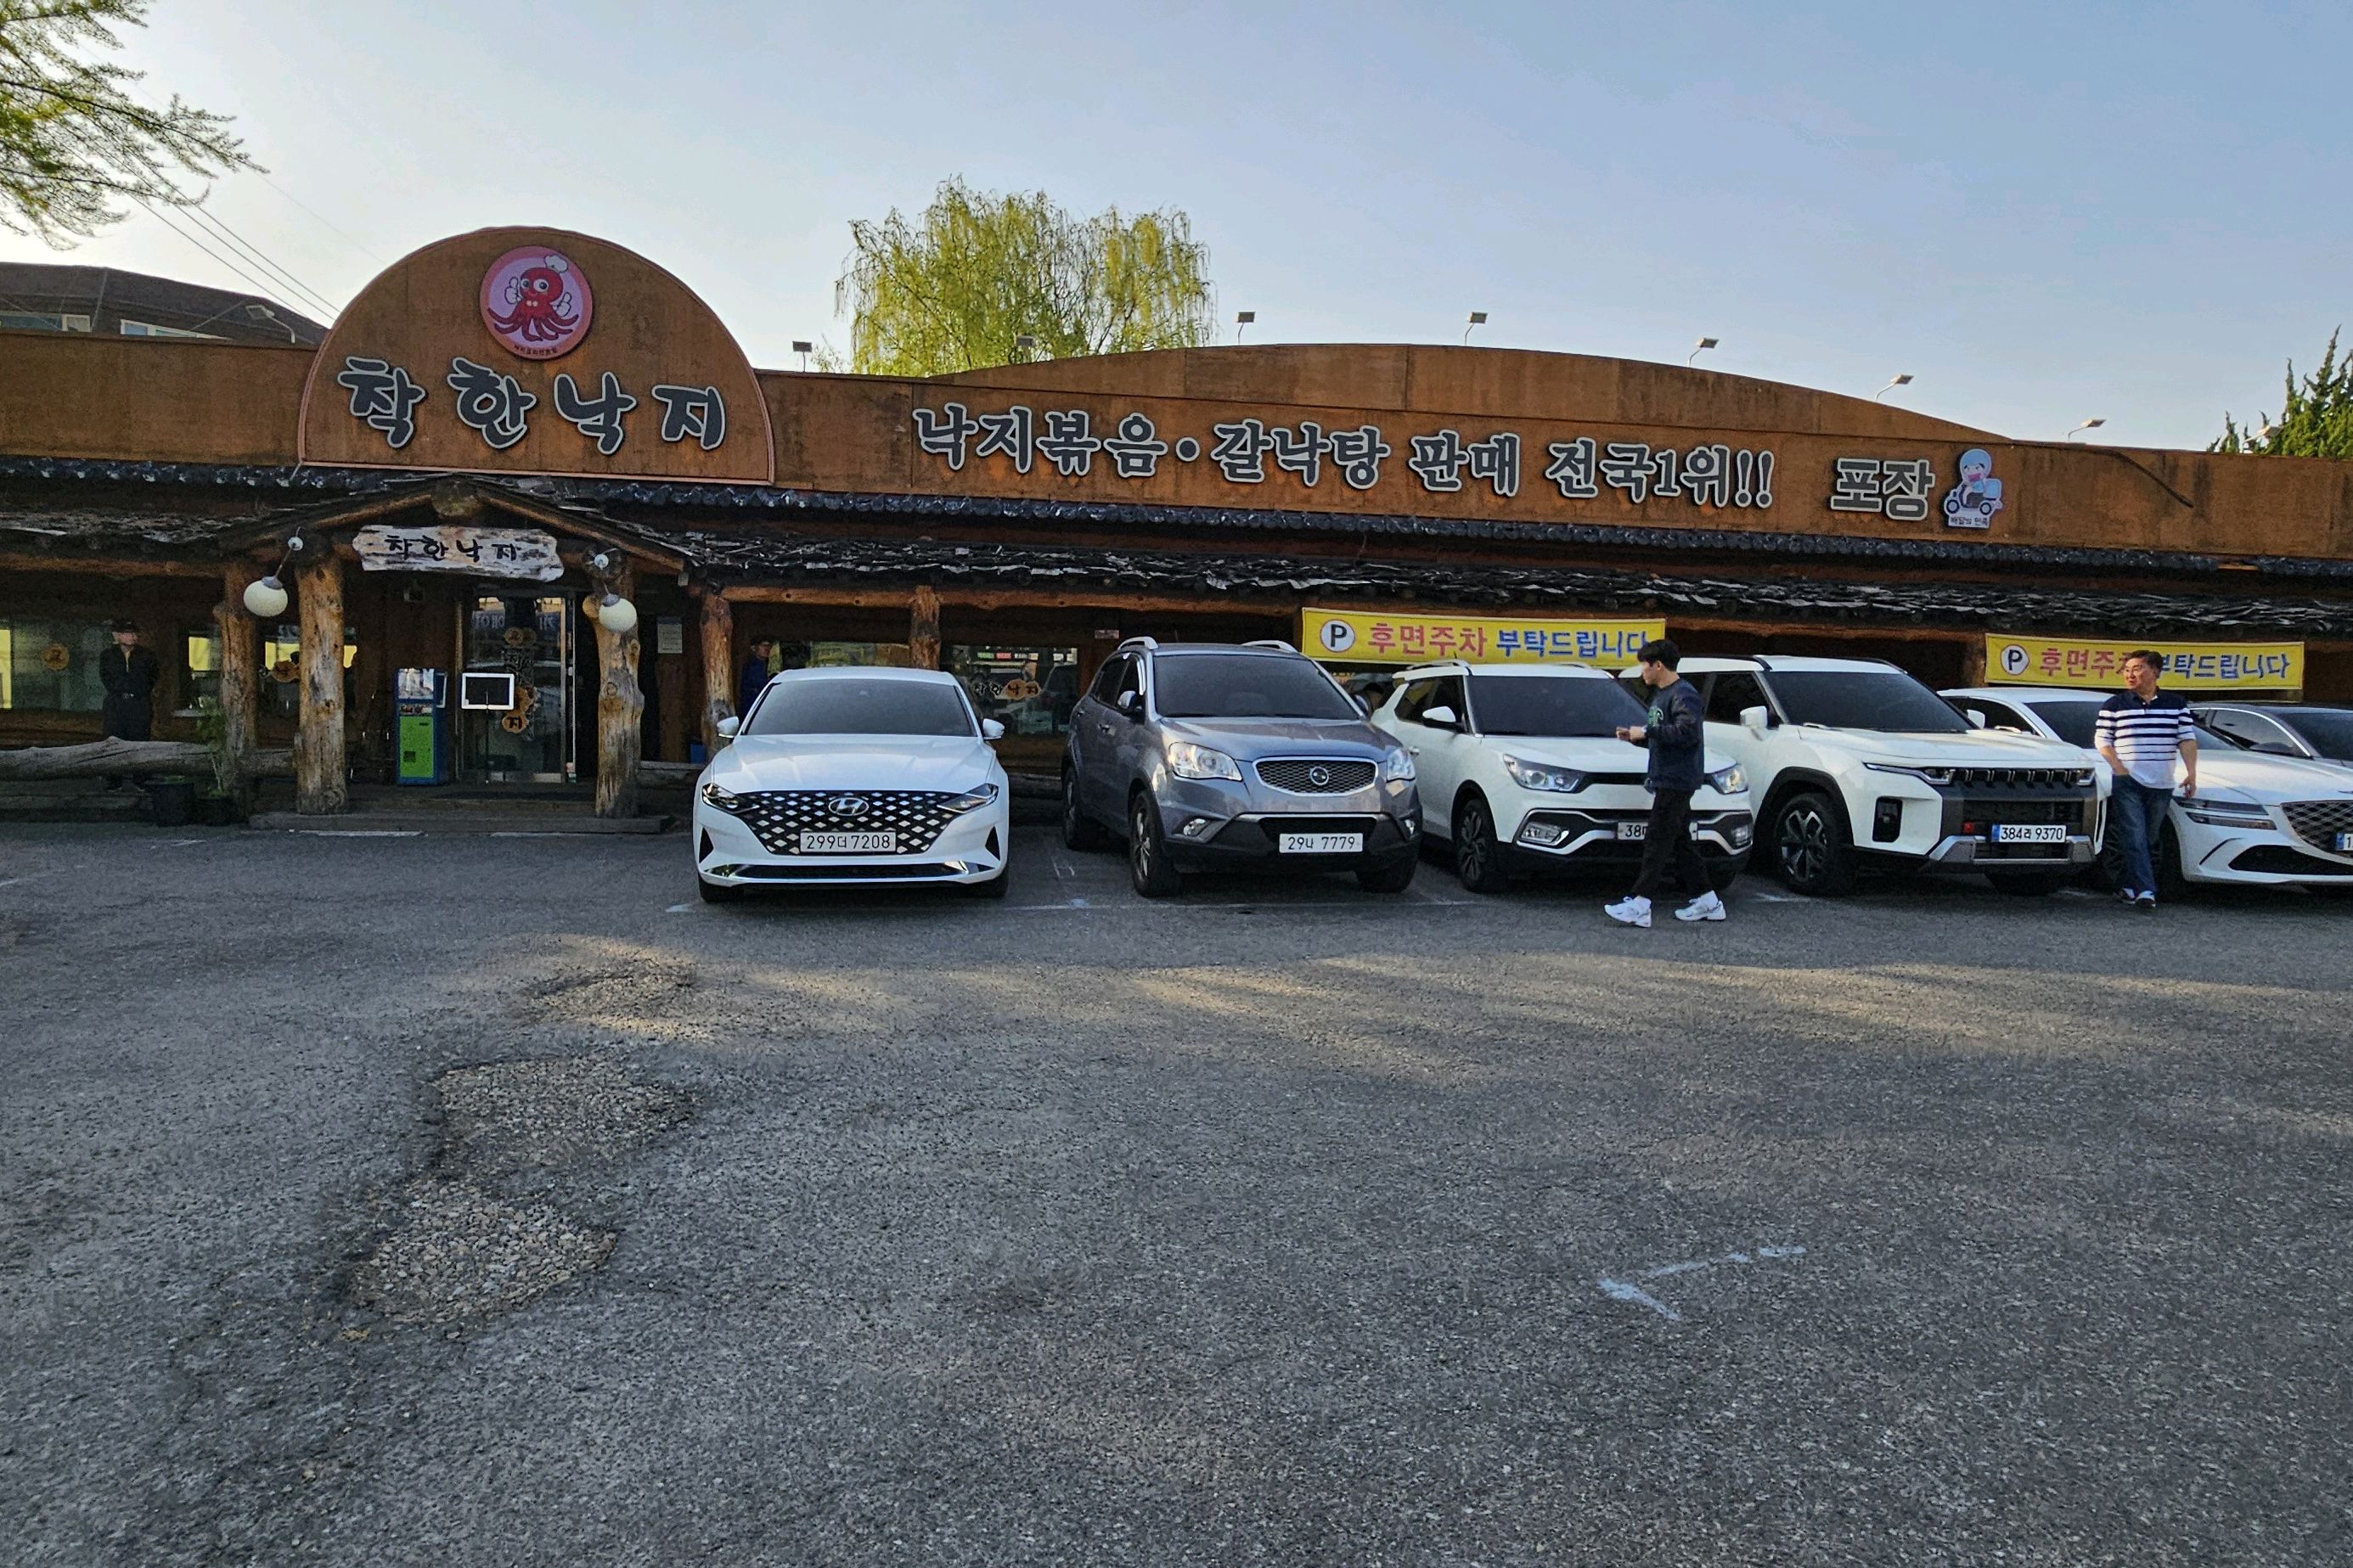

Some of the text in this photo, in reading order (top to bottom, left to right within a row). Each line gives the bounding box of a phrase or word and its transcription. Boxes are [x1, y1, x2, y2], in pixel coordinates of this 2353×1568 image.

[337, 355, 727, 457] 착한낙지
[1409, 429, 1522, 497] 판매
[1545, 436, 1776, 509] 전국1위!!
[1829, 456, 1935, 523] 포장
[385, 534, 519, 563] 착한낙지
[1368, 622, 1488, 658] 후면주차
[1495, 629, 1651, 658] 부탁드립니다
[807, 834, 890, 850] 299더 7208
[1287, 835, 1355, 851] 29나 7779
[2035, 827, 2063, 840] 9370
